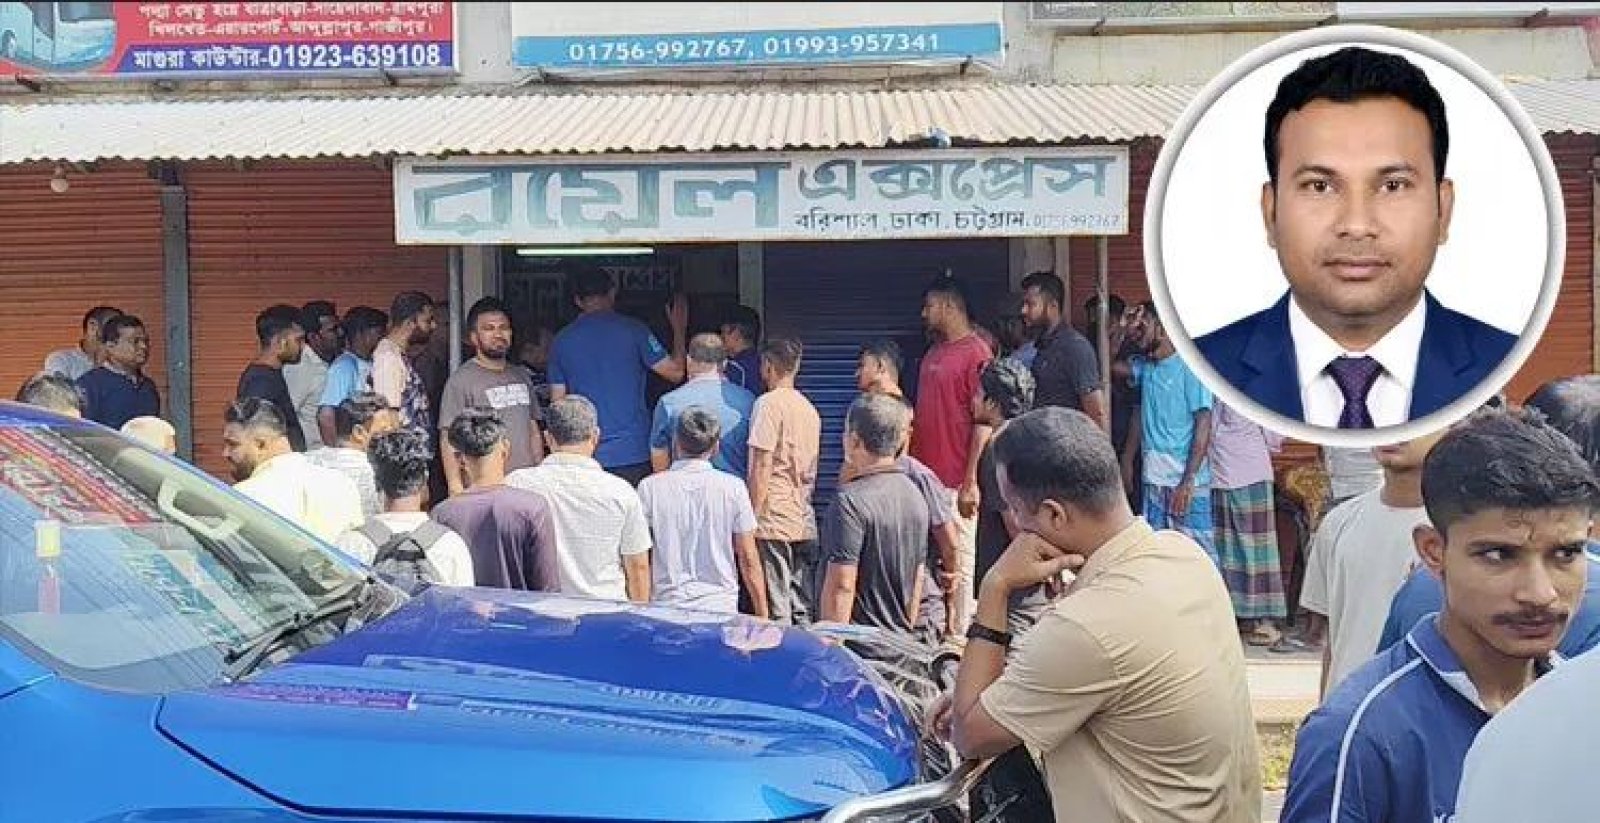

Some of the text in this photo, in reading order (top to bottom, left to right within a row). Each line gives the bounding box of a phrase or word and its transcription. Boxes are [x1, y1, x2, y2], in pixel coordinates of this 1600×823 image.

[175, 3, 206, 20] সেতু
[212, 3, 239, 17] হয়ে
[133, 48, 186, 68] মাগুরা
[571, 33, 938, 61] 01756-992767, 01993-957341
[411, 157, 1116, 236] রয়েল এক্সপ্রেস
